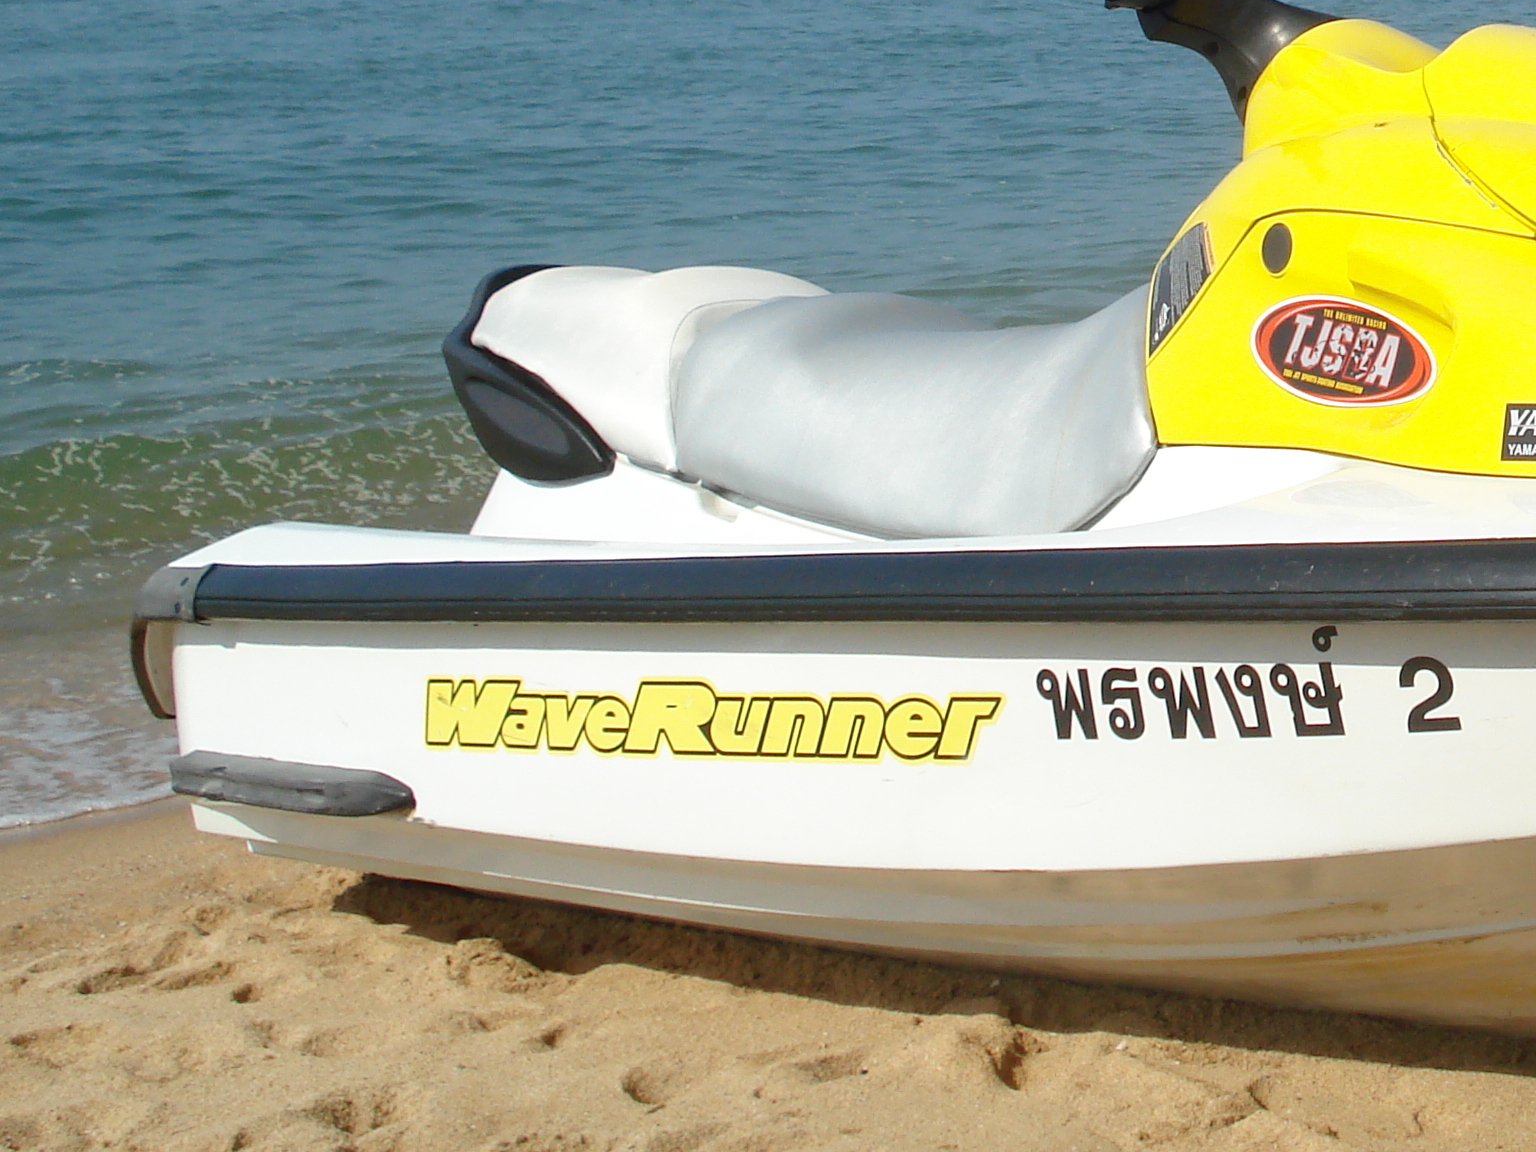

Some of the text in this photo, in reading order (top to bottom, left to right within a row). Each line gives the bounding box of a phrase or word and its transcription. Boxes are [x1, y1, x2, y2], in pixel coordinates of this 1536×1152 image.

[1284, 314, 1400, 388] TJSBA
[425, 678, 1001, 760] WaveRunner
[1399, 656, 1462, 733] 2
